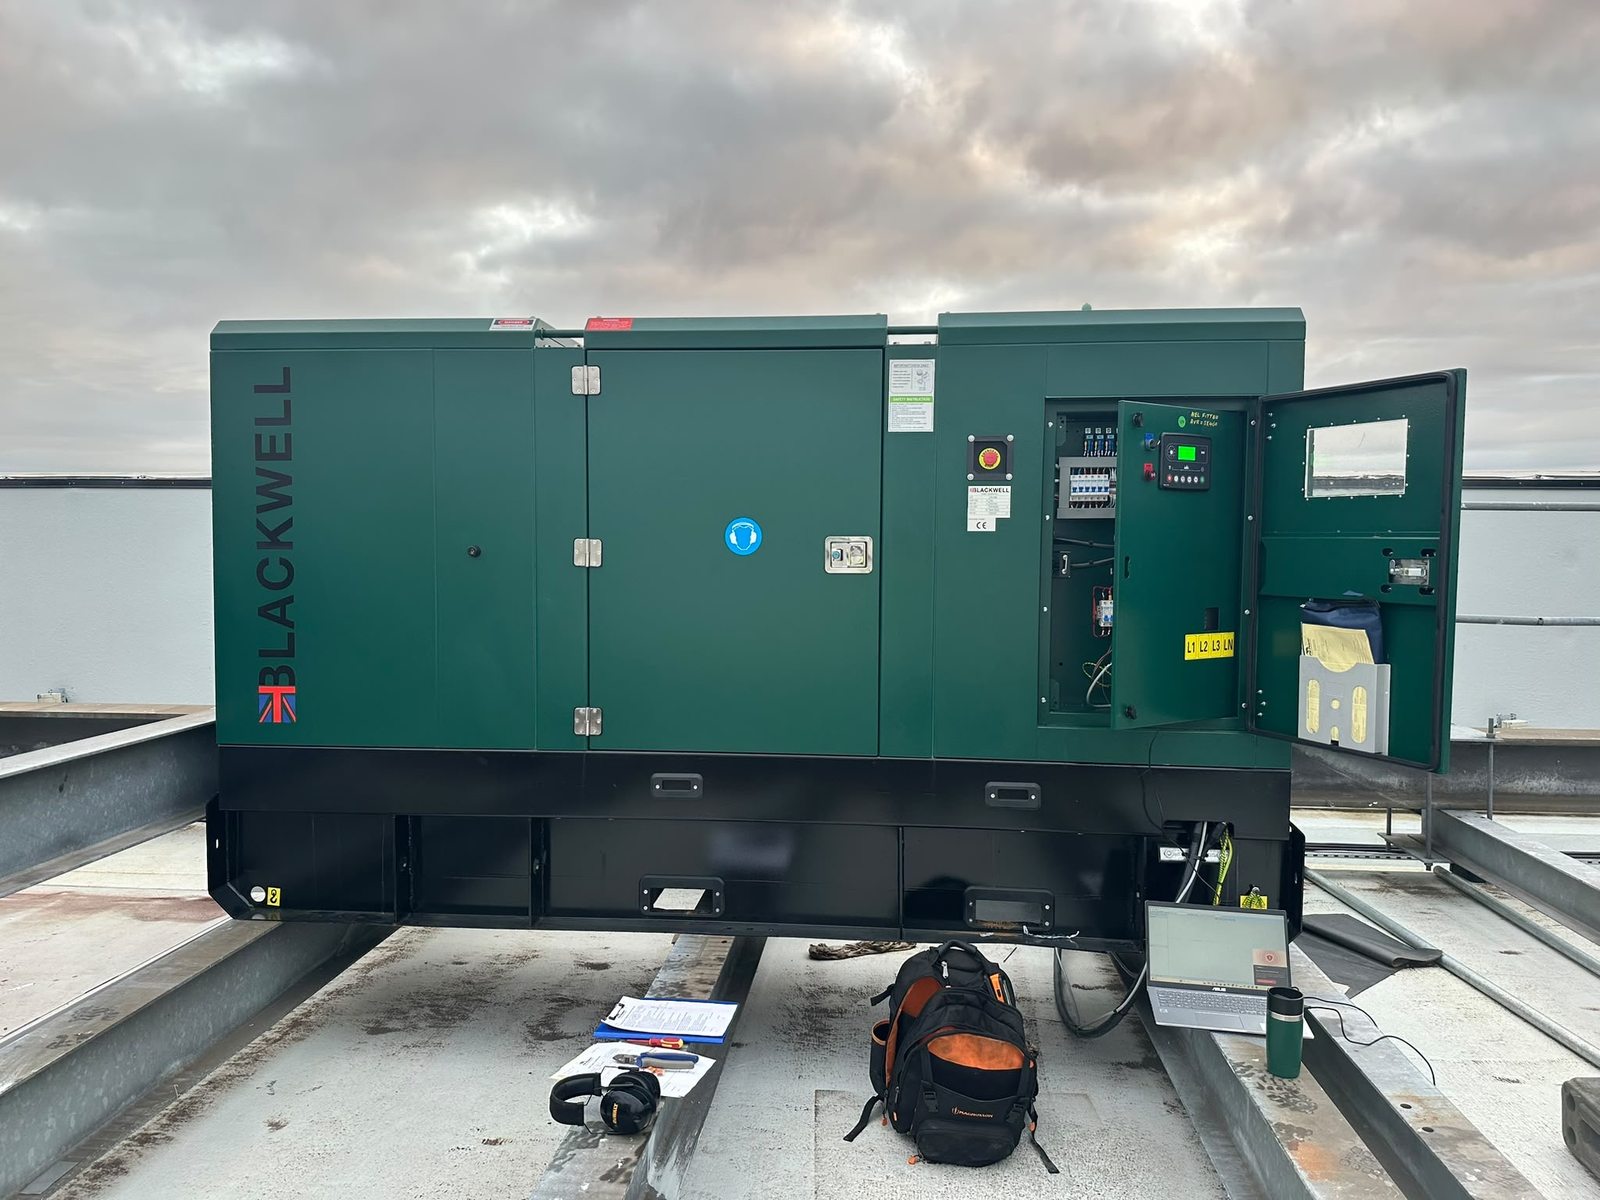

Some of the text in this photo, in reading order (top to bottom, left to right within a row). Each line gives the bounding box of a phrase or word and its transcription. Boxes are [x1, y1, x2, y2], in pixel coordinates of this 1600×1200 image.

[253, 366, 296, 692] BLACKWELL
[1187, 641, 1195, 654] L1
[1200, 640, 1208, 652] L2
[1212, 639, 1221, 652] L3
